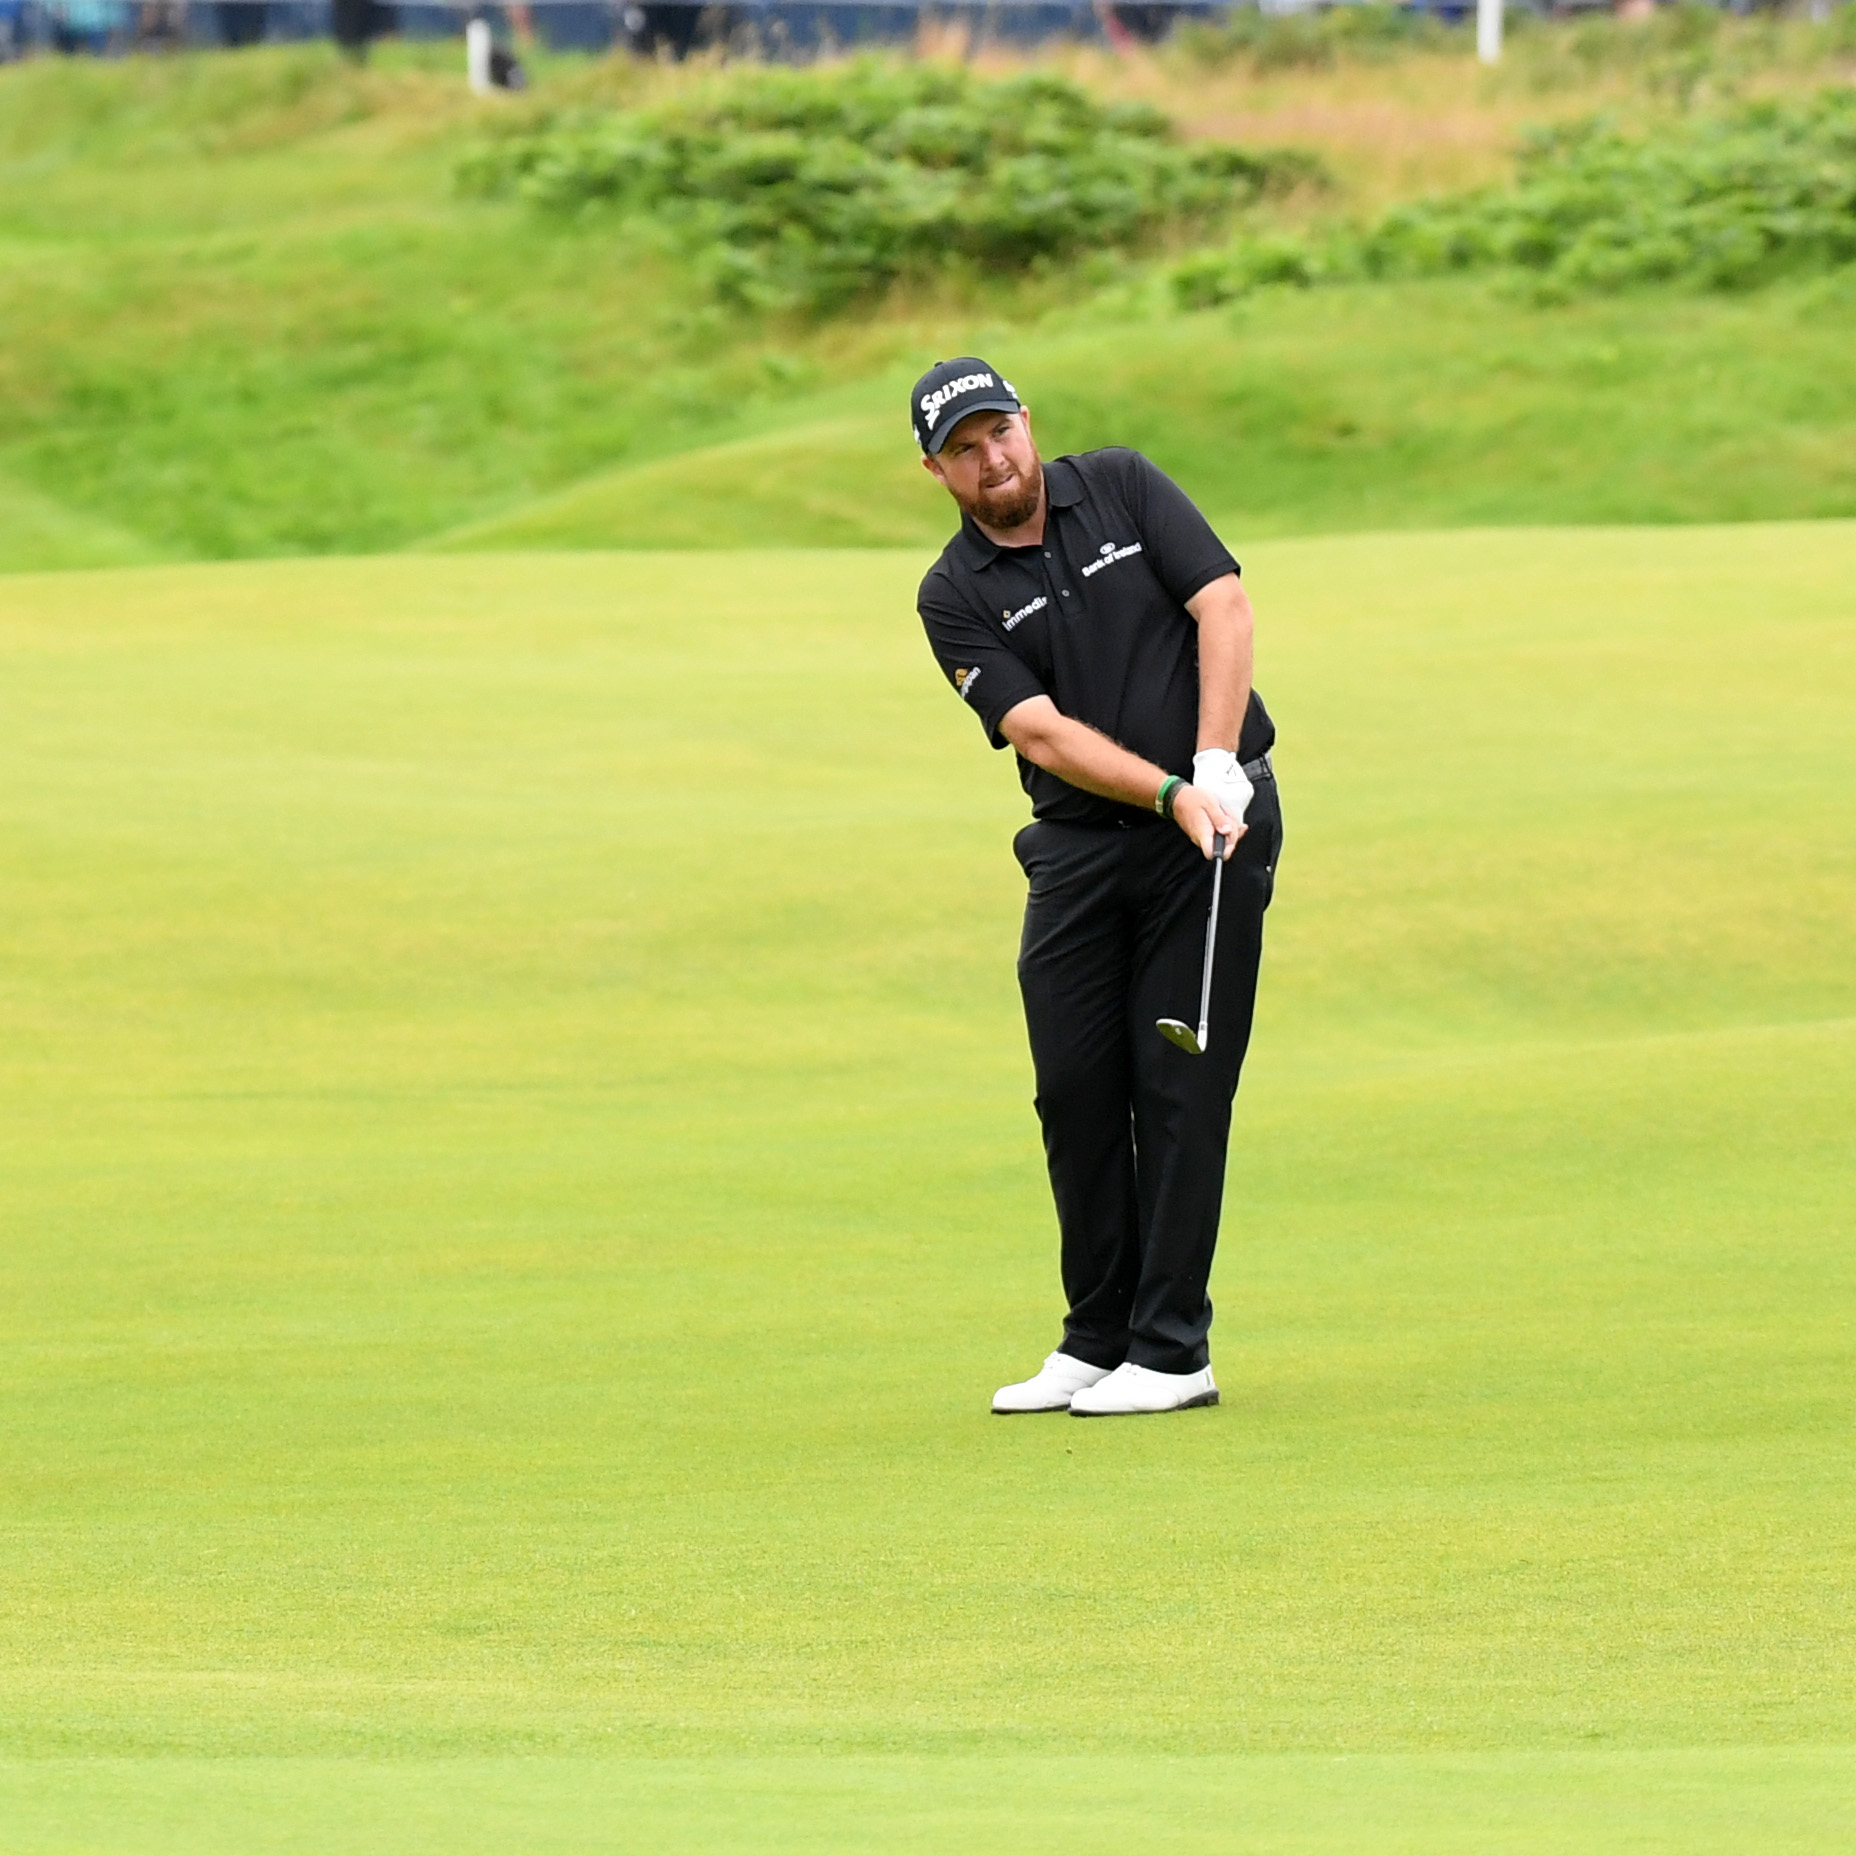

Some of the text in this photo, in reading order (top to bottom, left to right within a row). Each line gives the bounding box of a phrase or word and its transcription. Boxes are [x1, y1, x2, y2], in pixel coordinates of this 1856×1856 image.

[920, 373, 994, 431] SRIXON
[1081, 558, 1106, 578] Bank
[1112, 541, 1143, 560] Ireland
